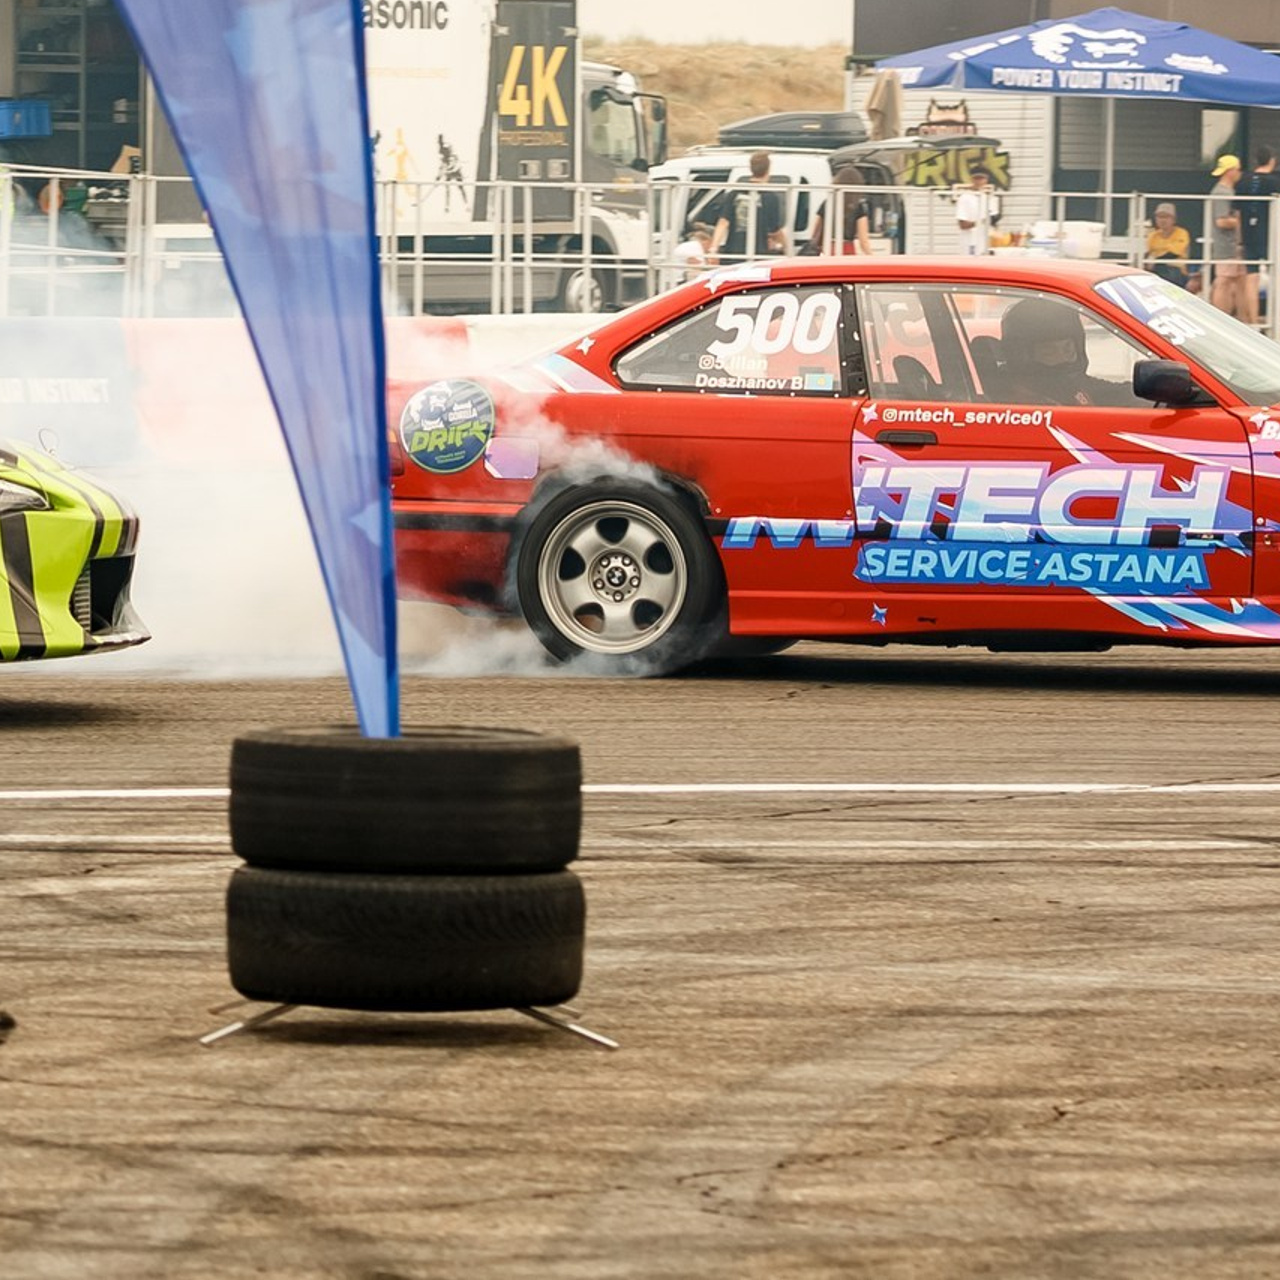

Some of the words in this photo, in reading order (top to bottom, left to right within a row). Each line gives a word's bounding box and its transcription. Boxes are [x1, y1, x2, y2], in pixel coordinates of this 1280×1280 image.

[498, 45, 569, 127] 4K
[991, 67, 1053, 88] POWER
[1057, 69, 1103, 90] YOUR
[1107, 71, 1184, 92] INSTINCT
[706, 292, 842, 357] 500
[695, 372, 788, 390] Doszhanov
[864, 547, 1031, 580] SERVICE
[1036, 552, 1204, 584] ASTANA
